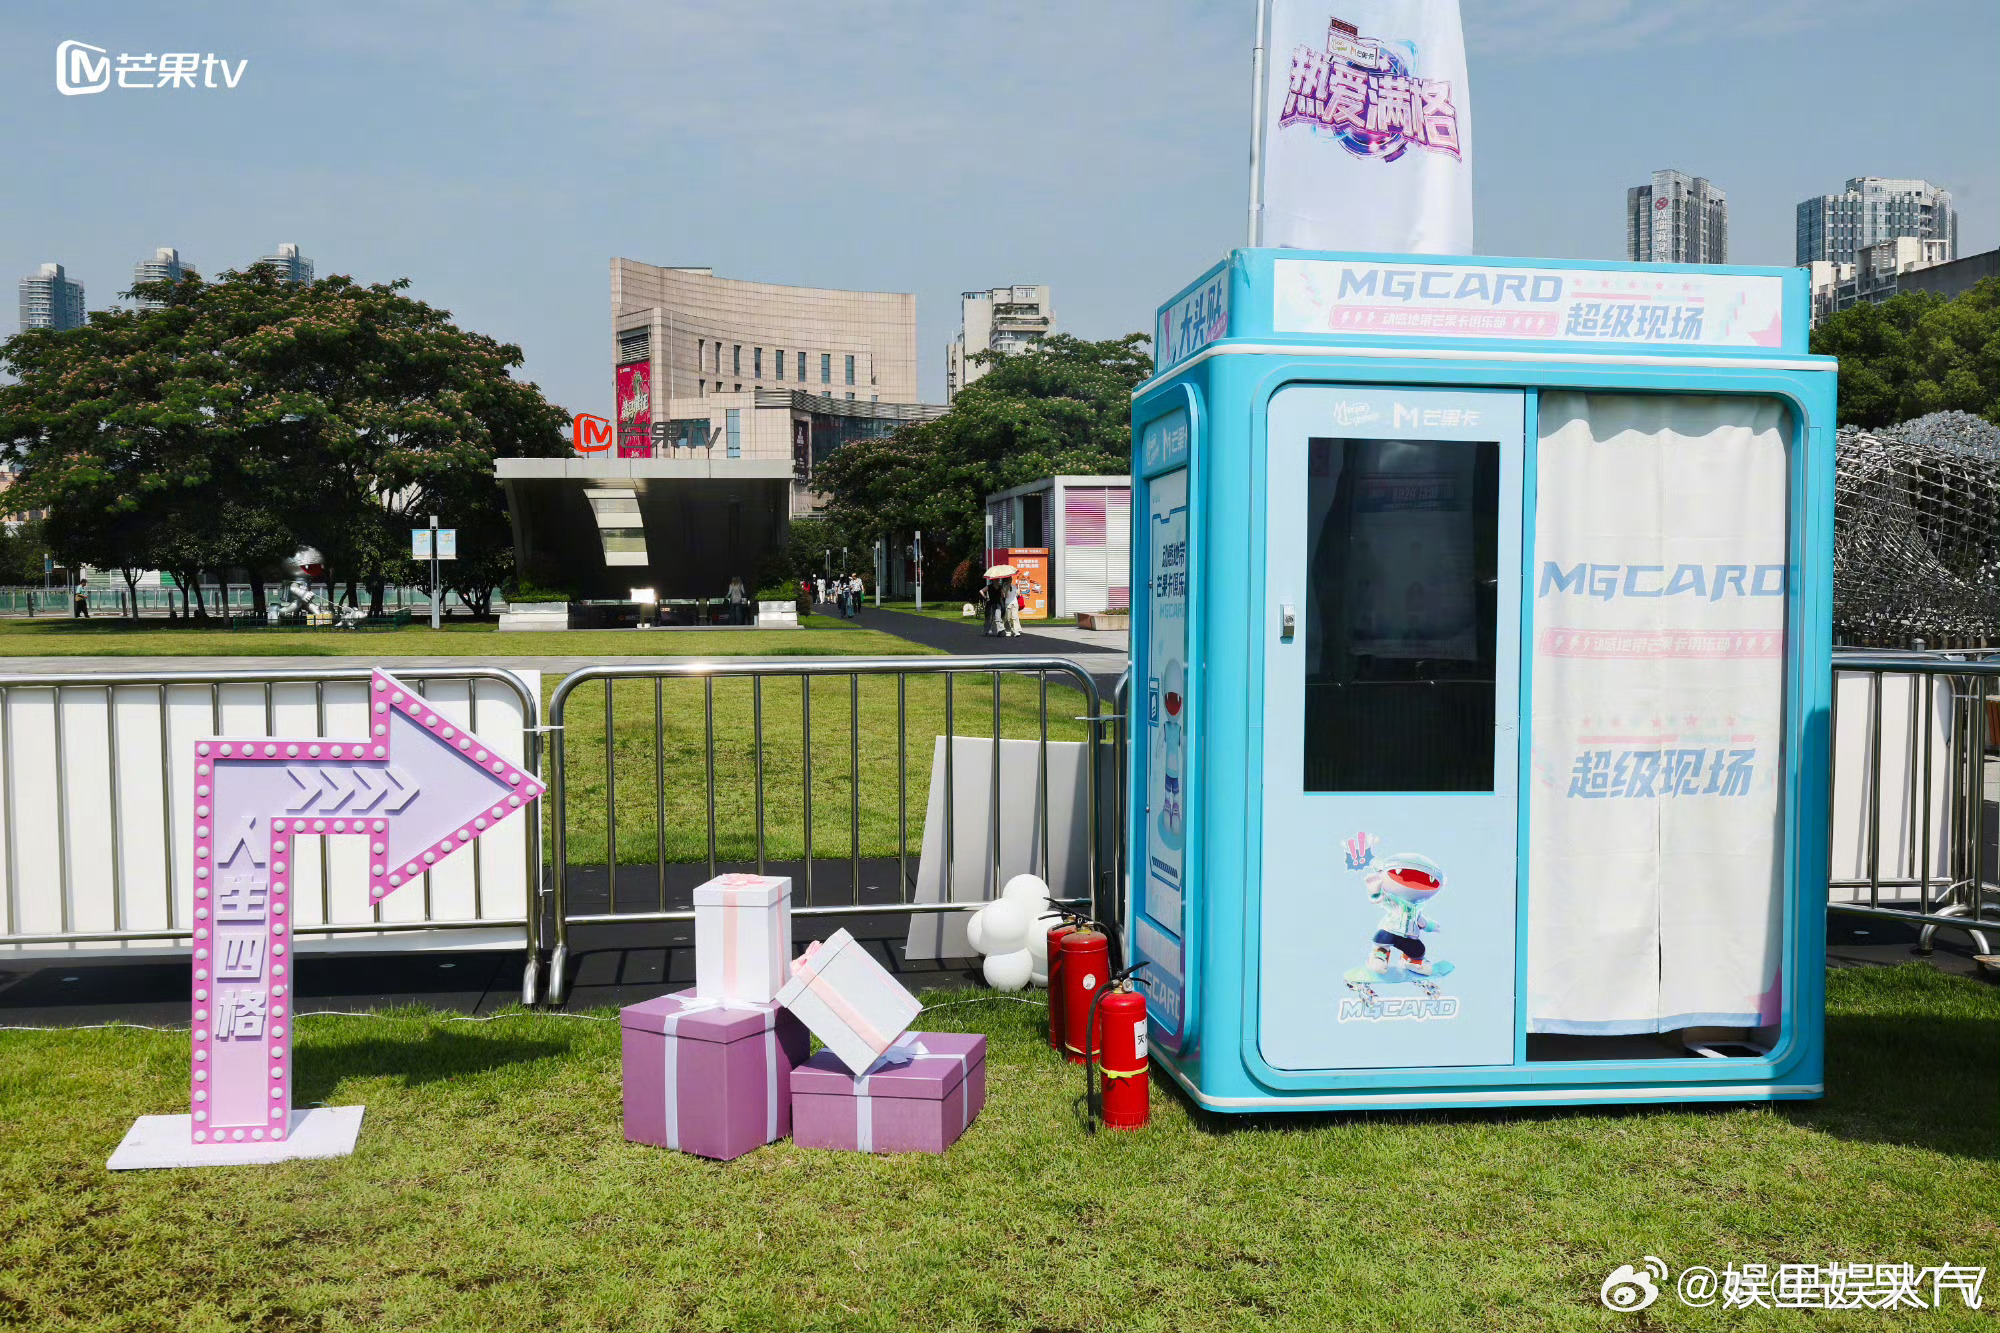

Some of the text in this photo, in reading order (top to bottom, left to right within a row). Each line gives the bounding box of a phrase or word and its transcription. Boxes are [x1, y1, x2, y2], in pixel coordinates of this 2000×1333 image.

[1281, 46, 1460, 151] 热爱满格
[1338, 269, 1564, 305] MGCARD
[1565, 302, 1705, 340] 超级现场
[617, 421, 722, 449] 芒果tv
[1156, 572, 1186, 598] 芒果卡俱乐
[1538, 561, 1786, 602] MGCARD
[1567, 748, 1756, 799] 超级现场
[216, 816, 267, 1037] 人生四格
[1340, 999, 1457, 1020] MGCARD
